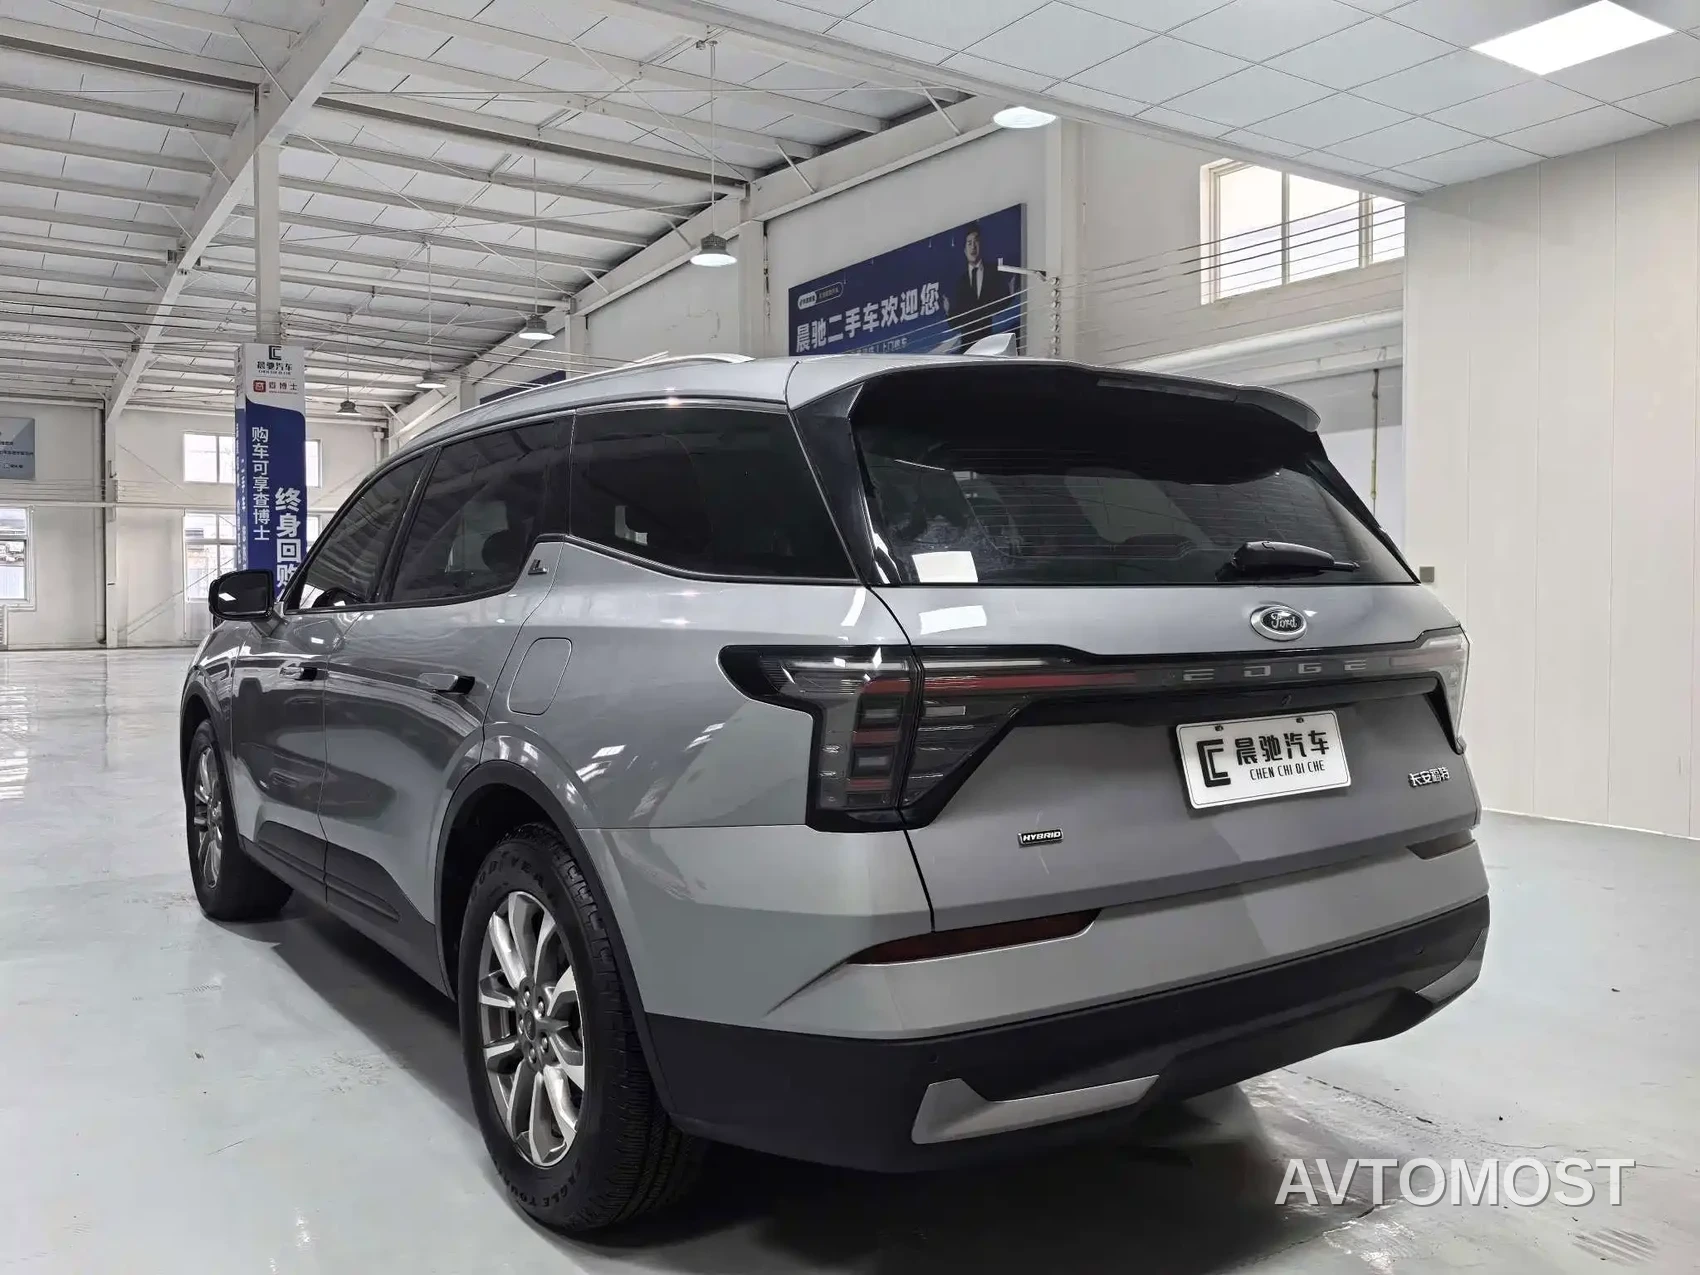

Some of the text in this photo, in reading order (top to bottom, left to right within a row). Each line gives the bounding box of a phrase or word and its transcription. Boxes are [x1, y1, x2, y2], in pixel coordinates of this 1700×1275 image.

[796, 282, 940, 352] 晨驰二手车欢迎您
[252, 427, 270, 541] 购车可享查博士
[1270, 611, 1298, 629] Ford
[1184, 661, 1366, 680] EDGE
[1235, 730, 1330, 766] 晨驰汽车
[1250, 760, 1326, 781] CHEN CHI QI CHE
[1023, 831, 1060, 841] HYBRID
